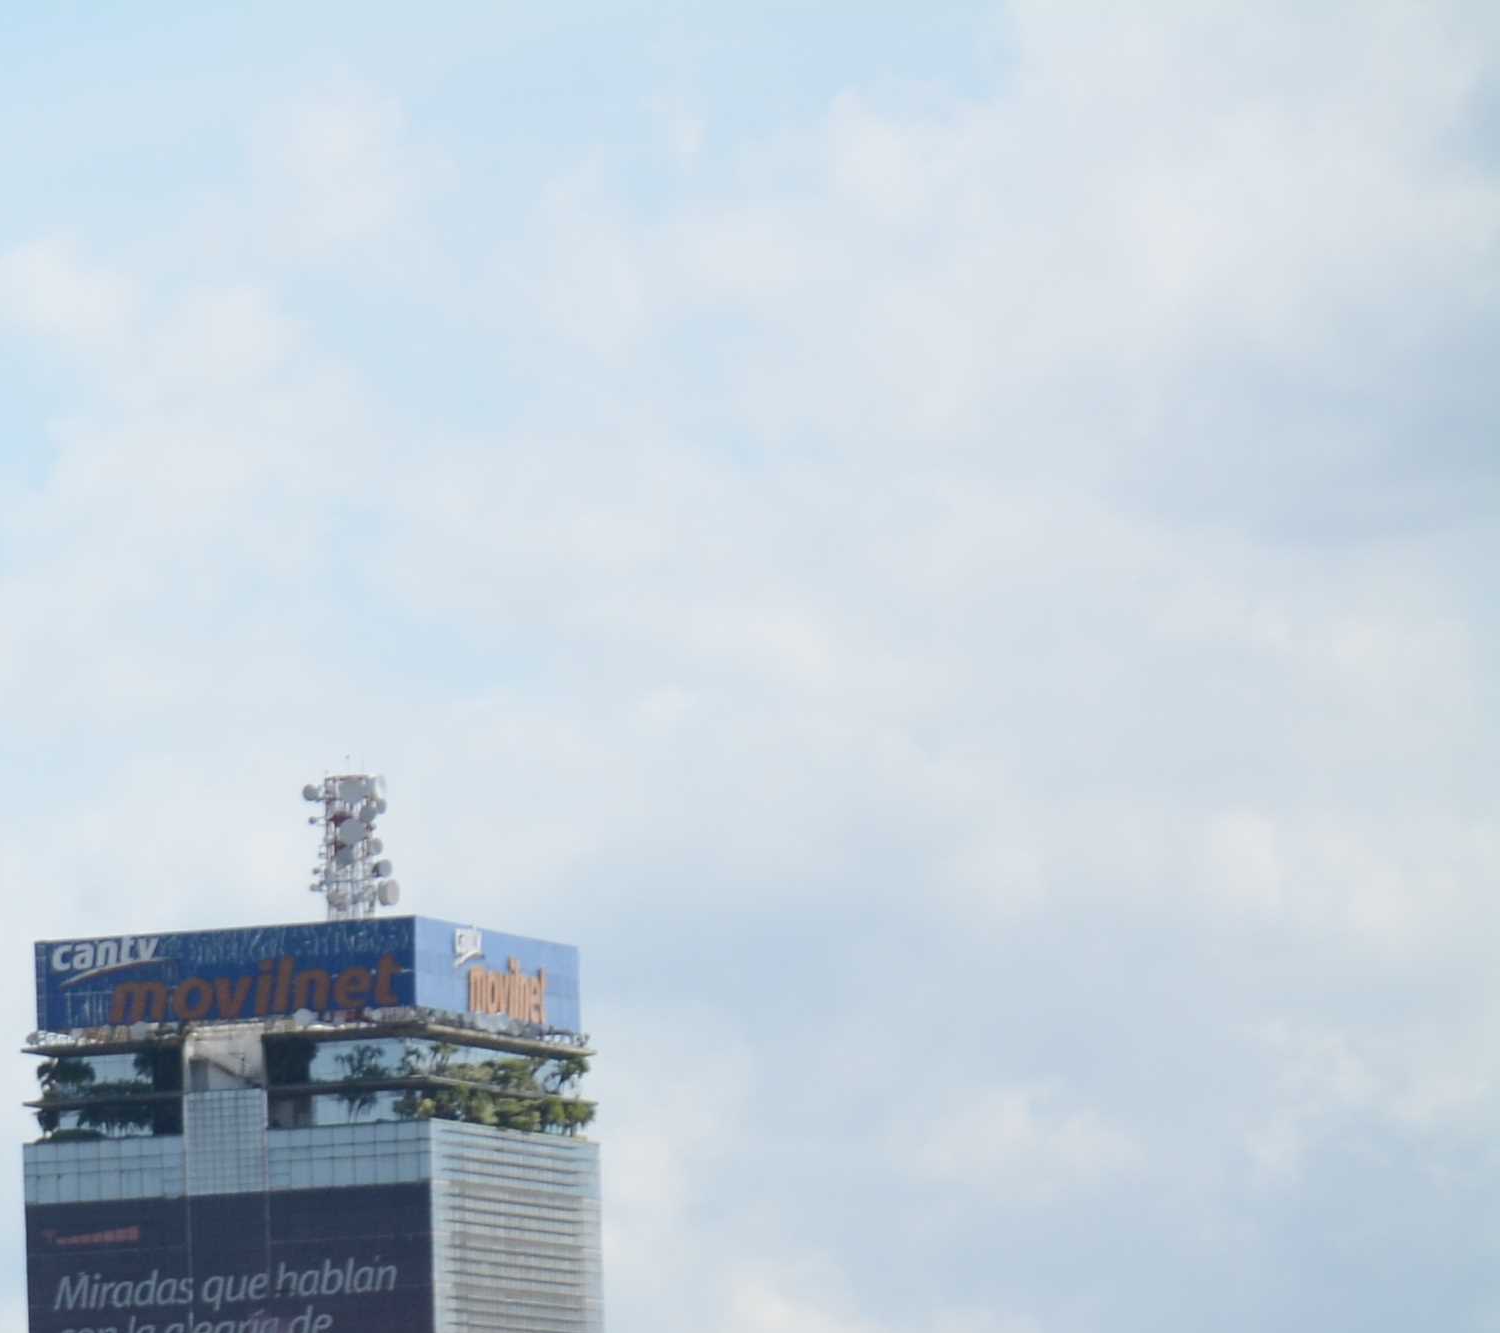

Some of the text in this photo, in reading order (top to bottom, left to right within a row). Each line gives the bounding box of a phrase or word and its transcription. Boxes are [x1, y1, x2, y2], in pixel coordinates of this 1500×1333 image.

[108, 953, 402, 1024] movilnet
[54, 1256, 398, 1310] Miradas que hablan
